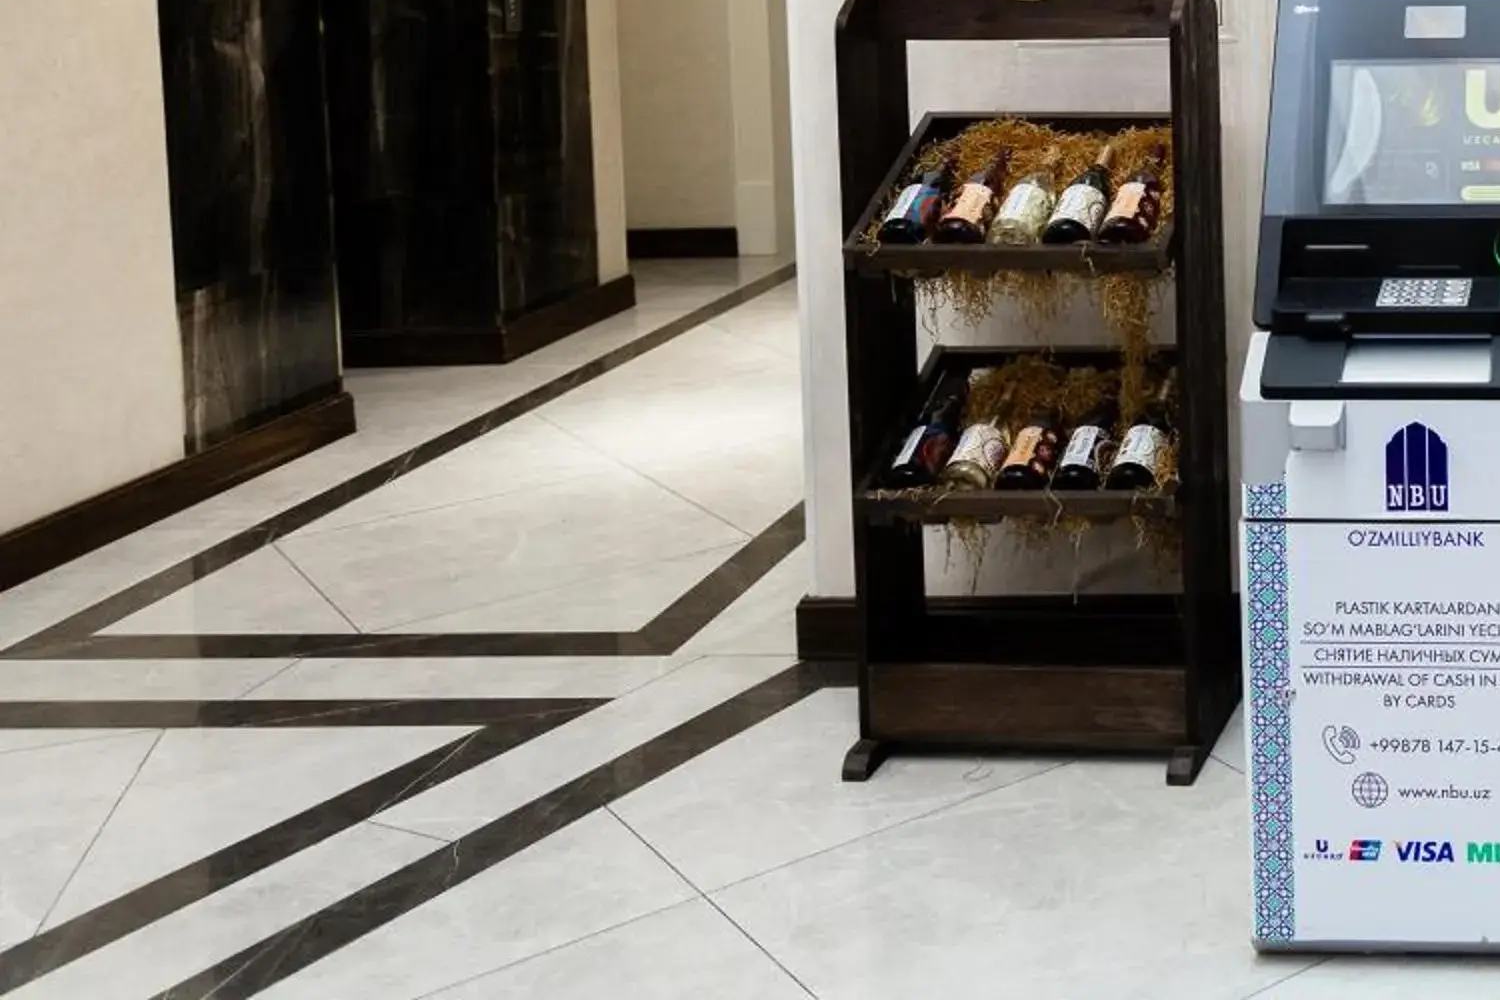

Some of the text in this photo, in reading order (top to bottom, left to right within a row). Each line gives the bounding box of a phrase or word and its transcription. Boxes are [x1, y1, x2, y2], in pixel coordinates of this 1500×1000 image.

[1388, 484, 1447, 507] NBU
[1347, 529, 1484, 547] O'ZMILLIYBANK
[1335, 601, 1500, 616] PLASTIK KARTALARDAN
[1313, 648, 1373, 662] СНЯТИЕ
[1377, 649, 1465, 663] НАЛИЧНЫХ
[1303, 672, 1403, 687] WITHDRAWAL
[1408, 673, 1430, 687] OF
[1433, 674, 1475, 687] CASH
[1479, 674, 1497, 687] IN
[1383, 695, 1456, 709] BY CARDS
[1370, 739, 1431, 754] +99878
[1397, 784, 1491, 799] www.nbu.uz
[1395, 841, 1455, 863] VISA
